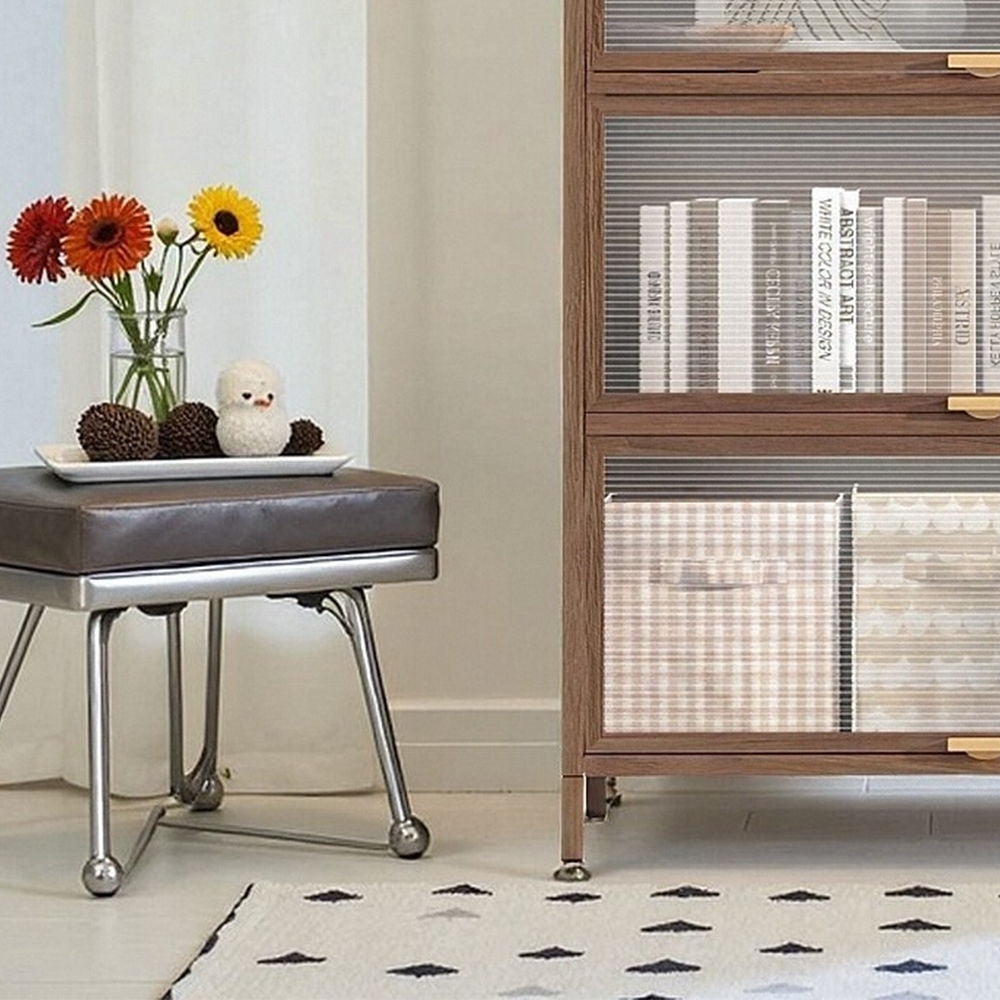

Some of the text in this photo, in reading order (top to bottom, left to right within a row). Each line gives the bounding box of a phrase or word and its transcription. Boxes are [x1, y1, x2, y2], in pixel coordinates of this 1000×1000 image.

[818, 198, 832, 362] WHITE COLOR IN DESIGN
[840, 208, 854, 324] ABSTRACT ART
[955, 287, 970, 346] ASTRID
